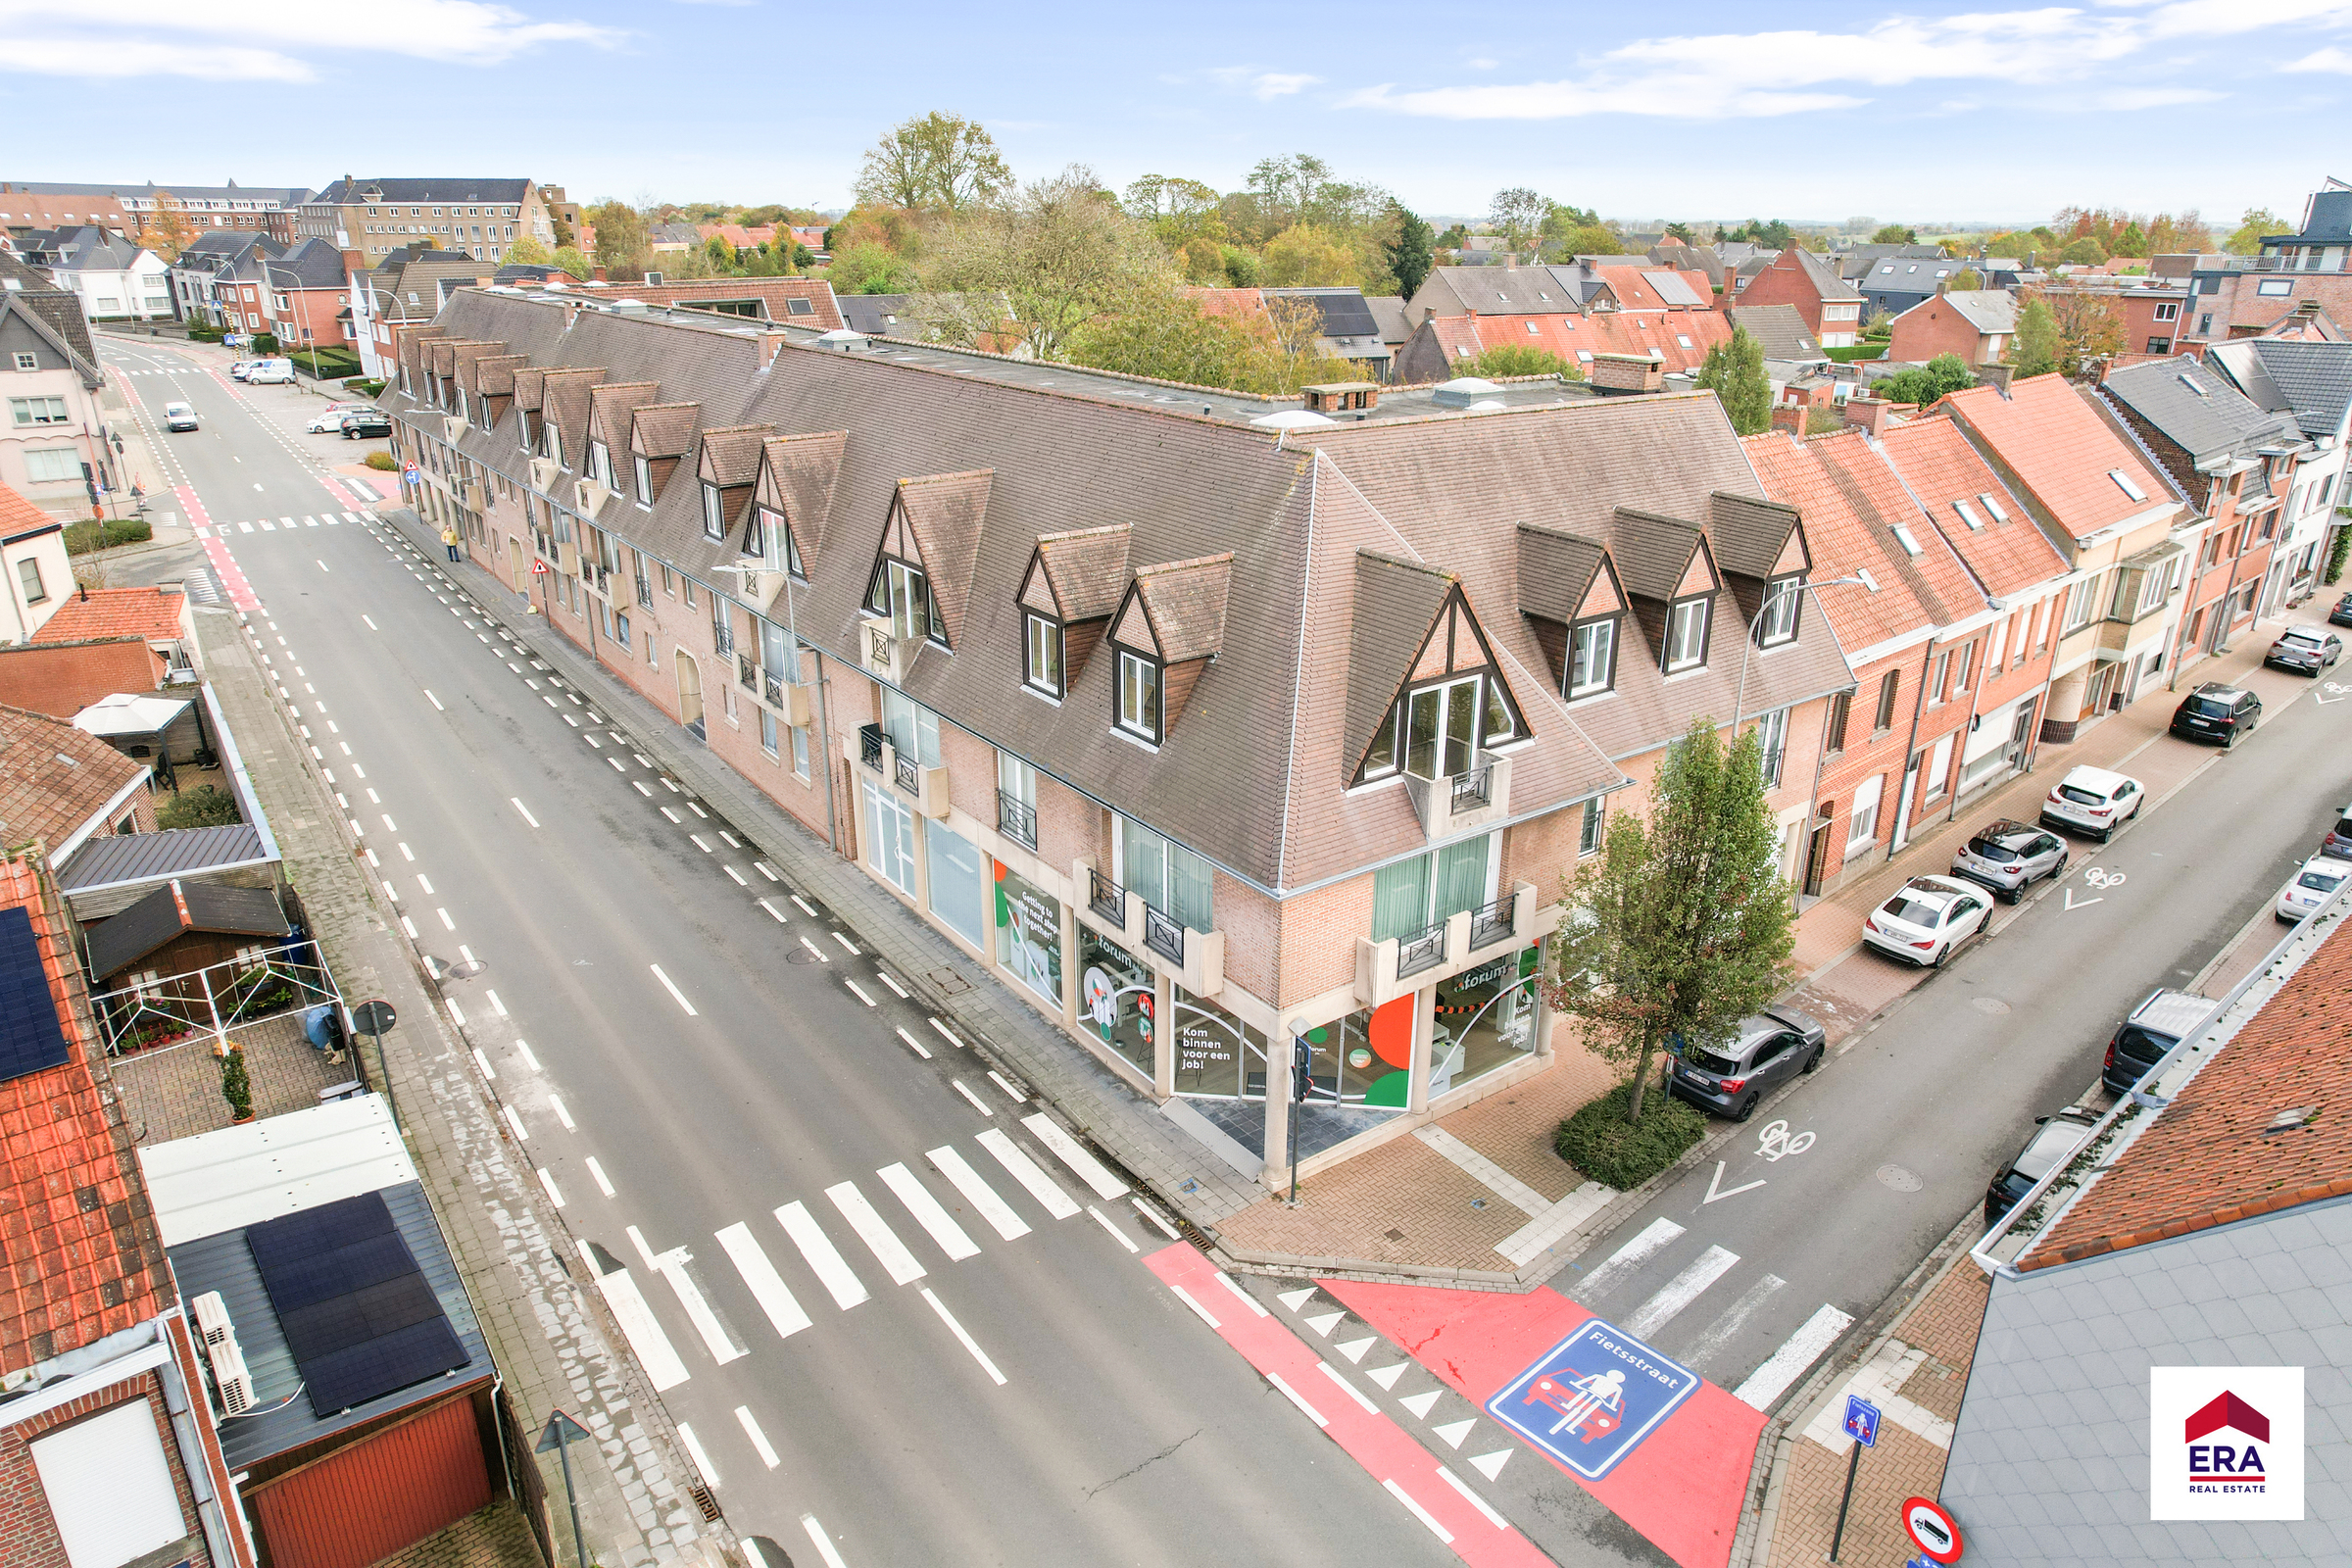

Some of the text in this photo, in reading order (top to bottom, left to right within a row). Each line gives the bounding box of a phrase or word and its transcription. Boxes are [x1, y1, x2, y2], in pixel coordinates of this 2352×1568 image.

[1019, 899, 1057, 935] the next step
[1022, 891, 1054, 918] Getting to
[1023, 914, 1052, 941] together!
[1099, 934, 1132, 969] forum
[1464, 964, 1507, 990] forum
[1183, 1027, 1208, 1038] Kom
[1183, 1038, 1221, 1049] binnen
[1512, 1032, 1528, 1048] job!
[1182, 1058, 1203, 1070] job!
[1183, 1050, 1230, 1060] voor een
[1589, 1331, 1679, 1389] Fietsstraat
